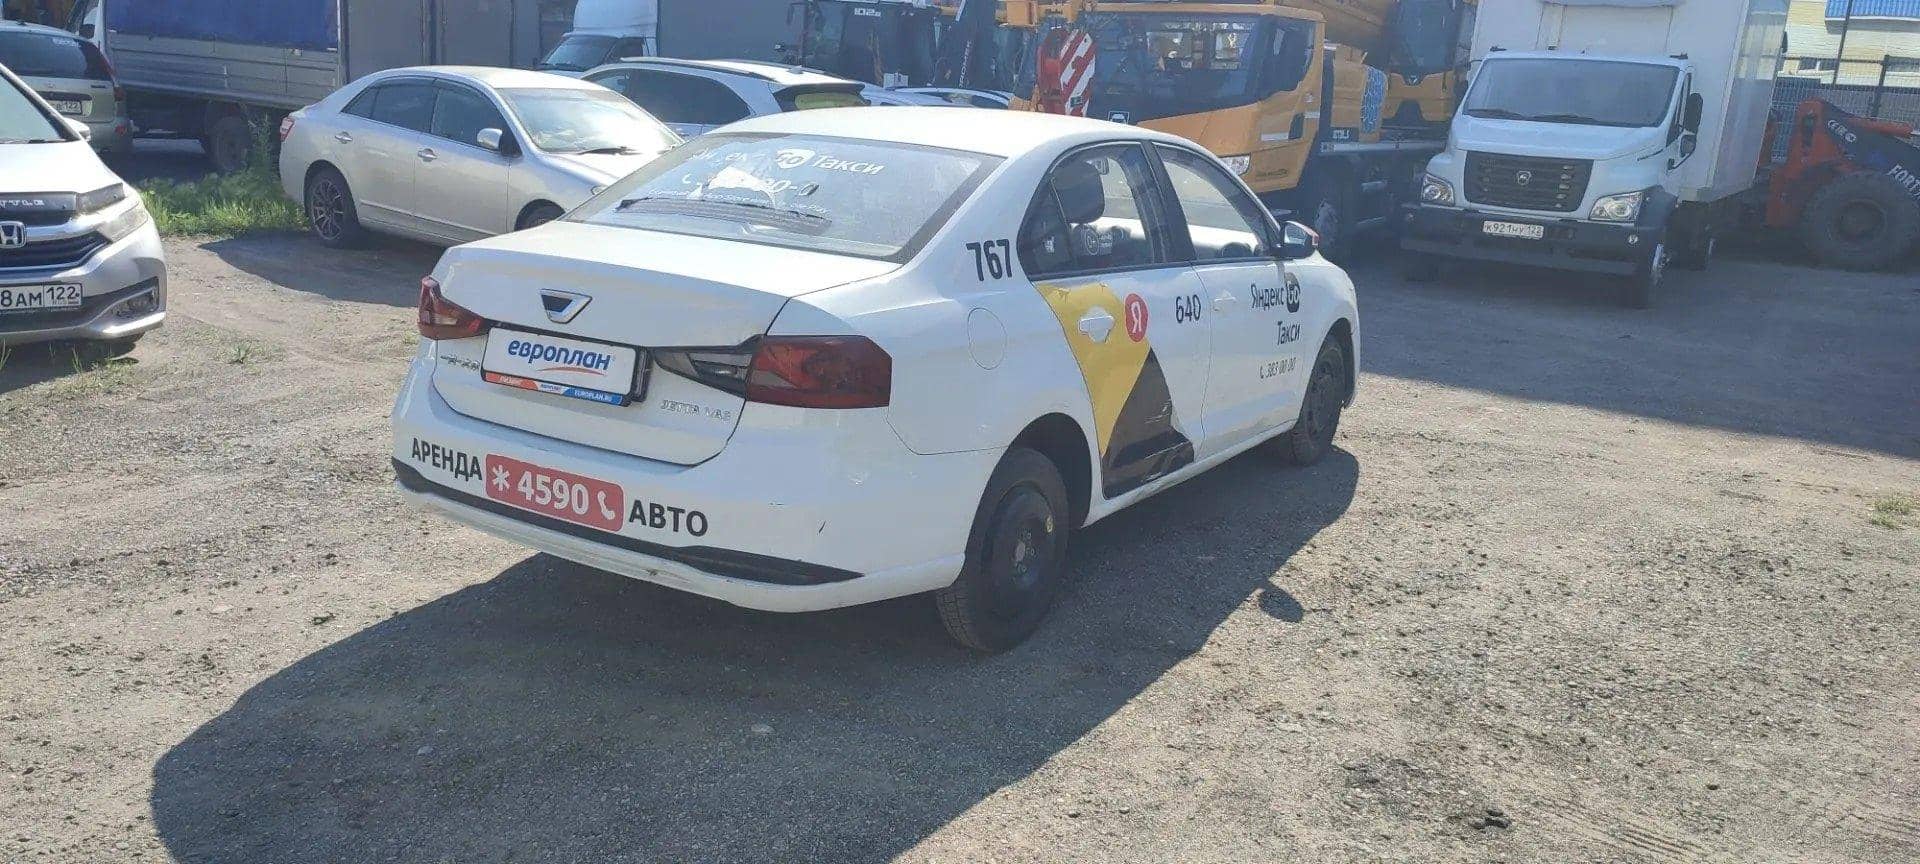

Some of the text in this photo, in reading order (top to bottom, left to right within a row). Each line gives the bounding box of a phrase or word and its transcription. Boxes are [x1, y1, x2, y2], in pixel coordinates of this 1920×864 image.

[811, 155, 885, 175] Такси
[966, 238, 1014, 282] 767
[1175, 294, 1201, 324] 640
[1251, 283, 1285, 311] Яндекс
[1131, 300, 1143, 335] Я
[1277, 321, 1301, 346] Такси
[507, 340, 612, 370] европлан
[411, 437, 483, 481] АРЕНДА
[517, 470, 589, 516] 4590
[629, 499, 709, 537] АВТО
